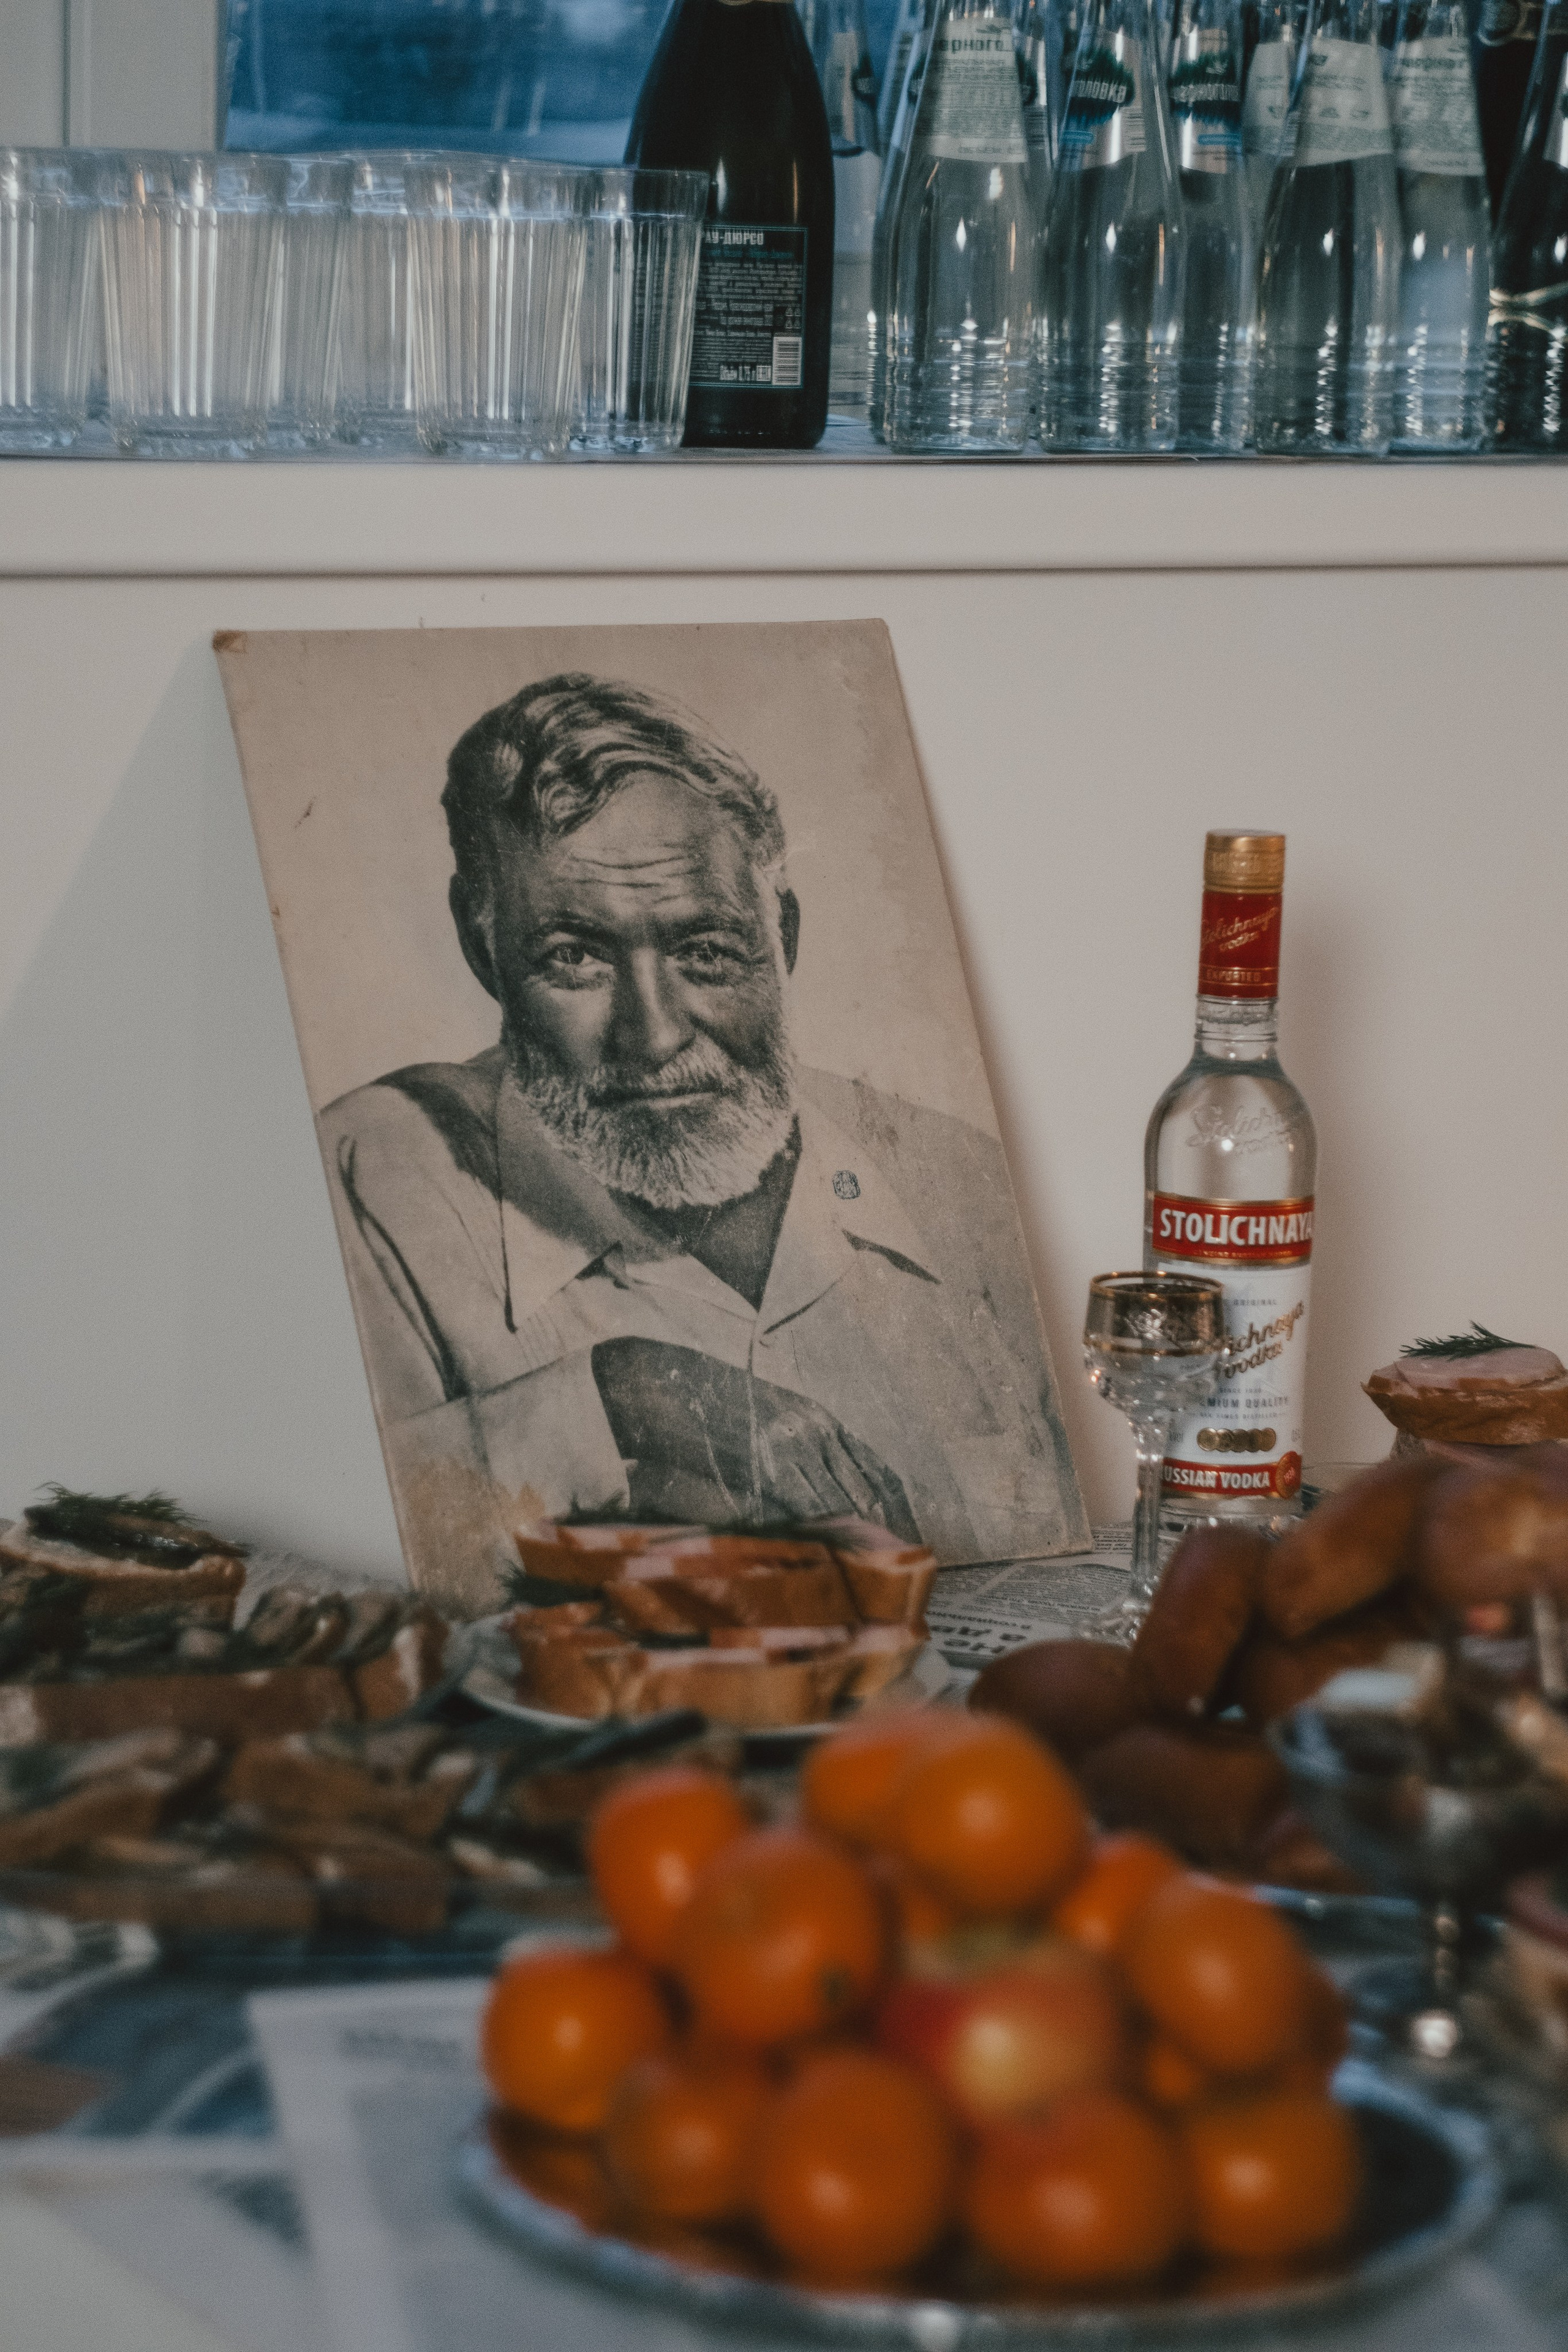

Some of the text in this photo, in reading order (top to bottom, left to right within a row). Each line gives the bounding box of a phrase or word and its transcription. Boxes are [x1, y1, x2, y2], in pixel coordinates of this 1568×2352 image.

[706, 232, 763, 245] АУ-ДЮРСО
[1160, 1208, 1314, 1246] STOLICHNAYA
[1245, 1396, 1287, 1409] QUALITY
[1219, 1471, 1270, 1489] VODKA
